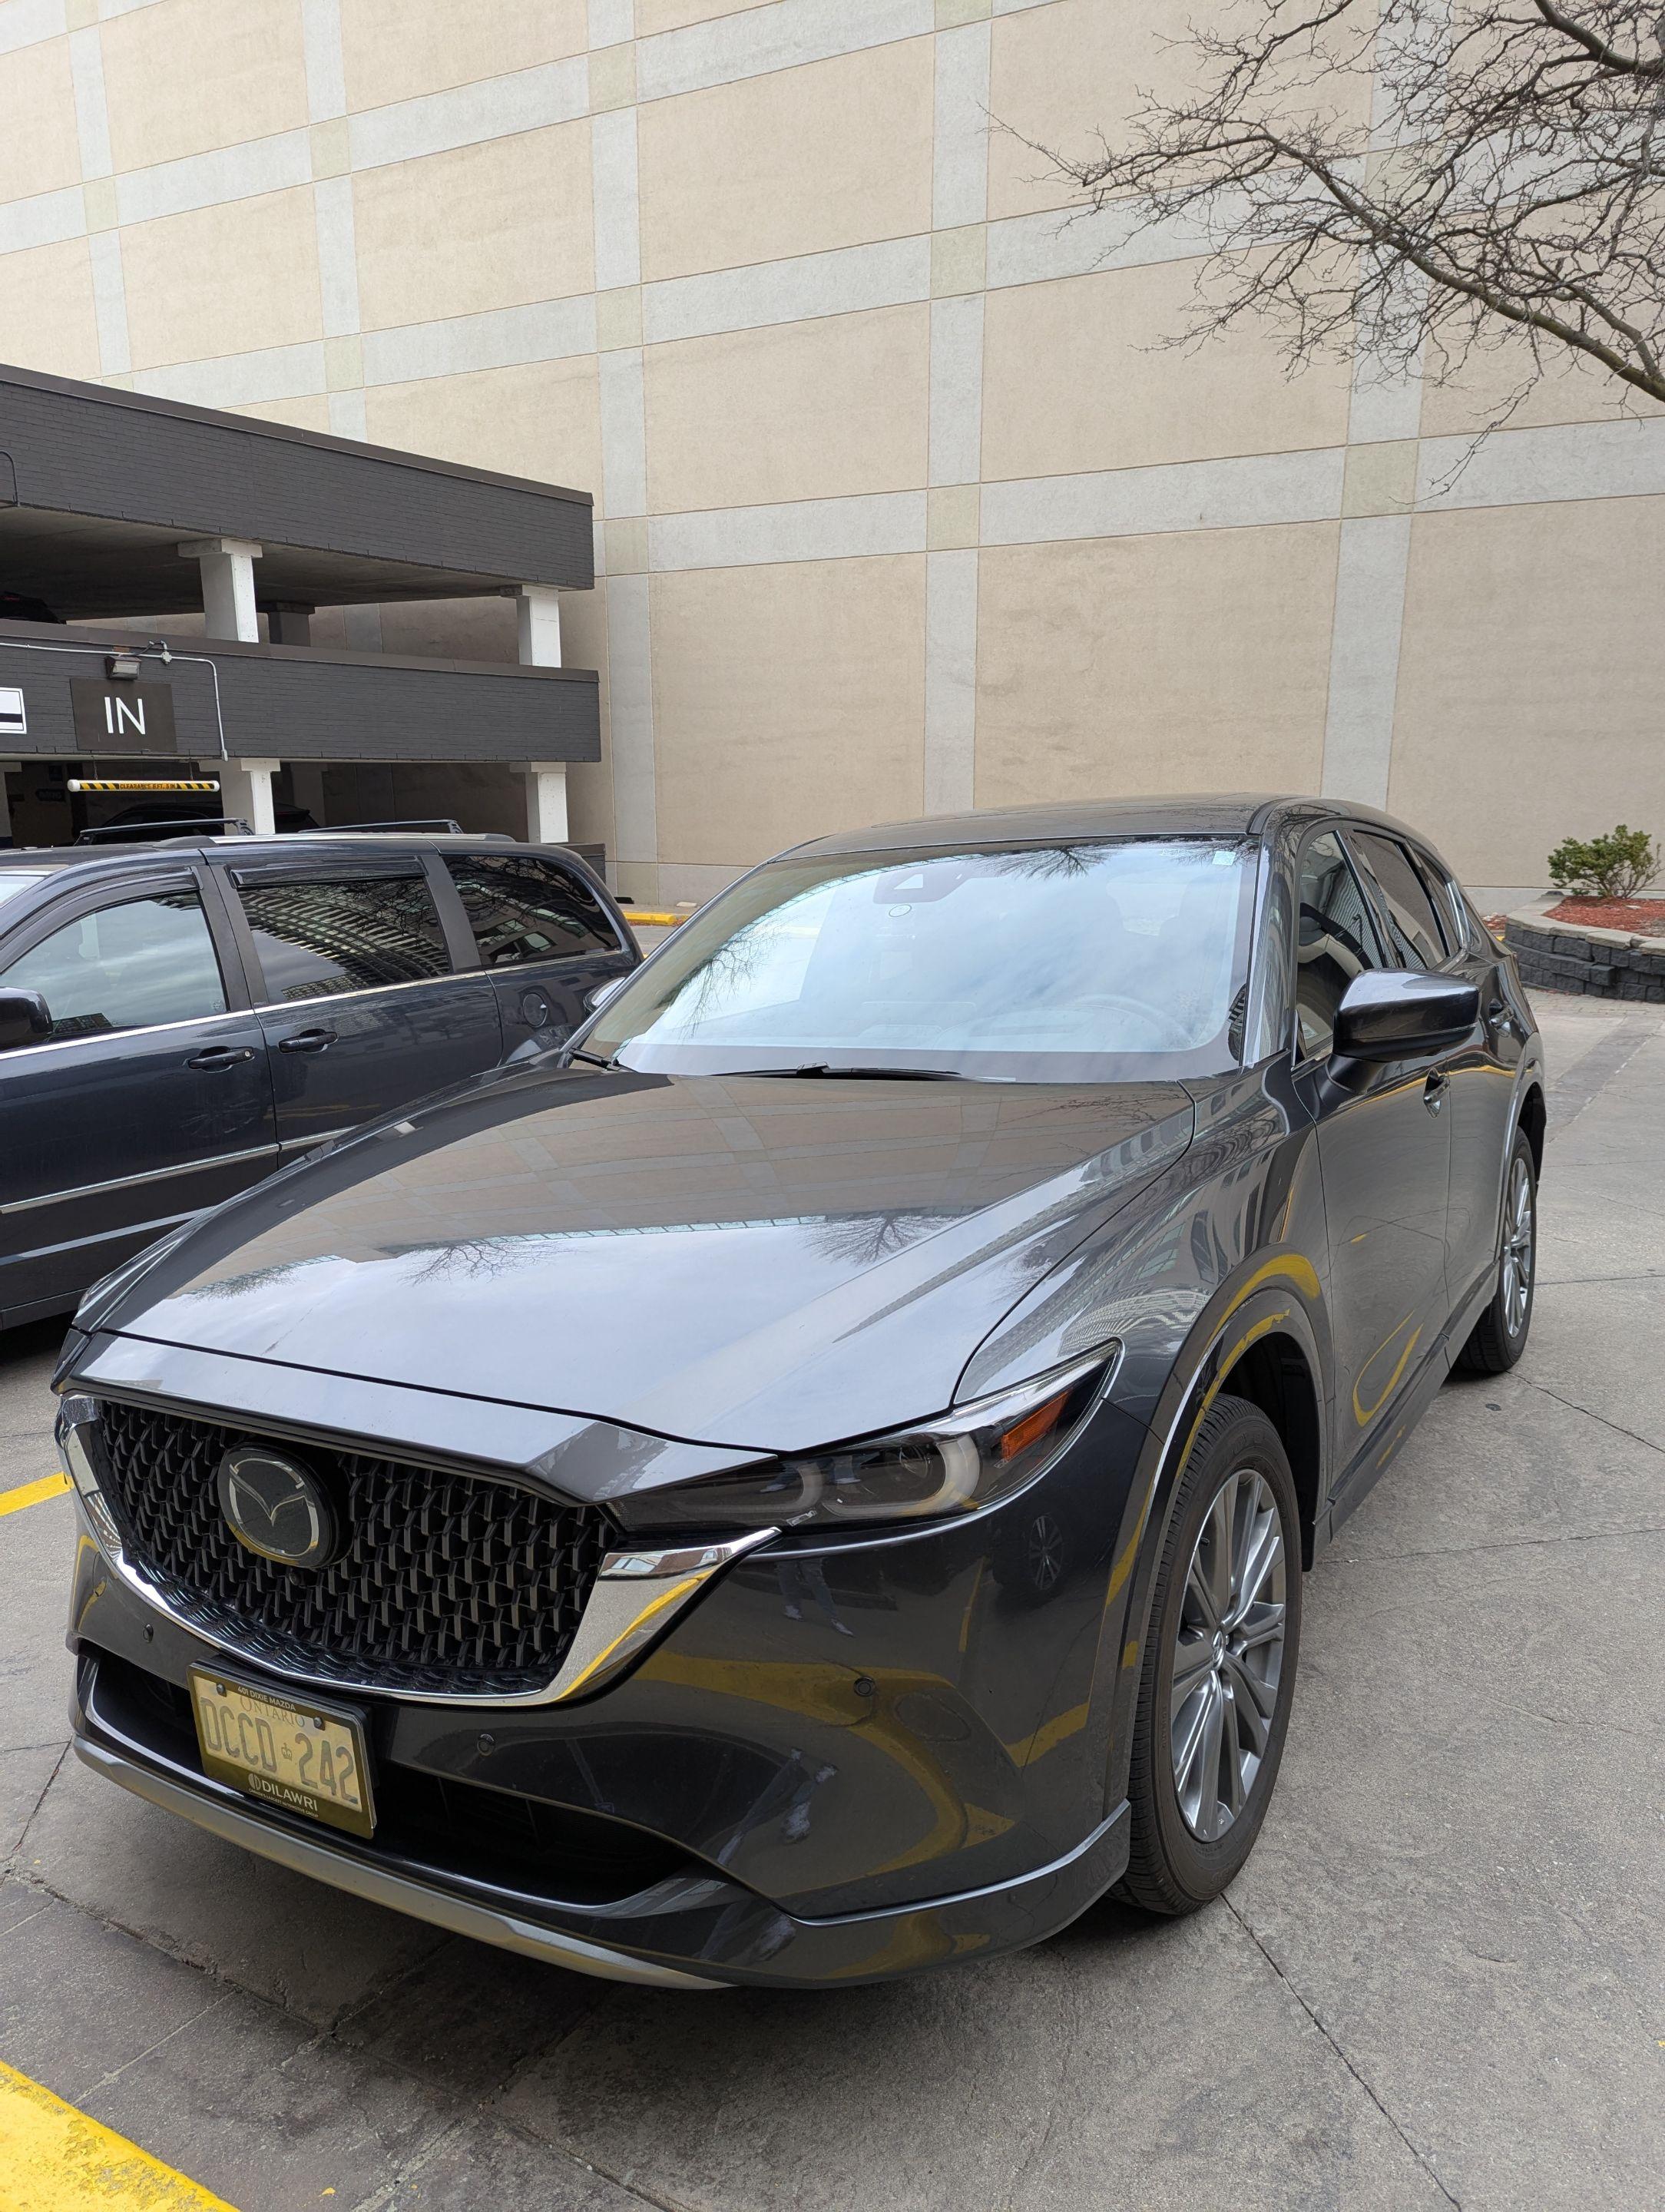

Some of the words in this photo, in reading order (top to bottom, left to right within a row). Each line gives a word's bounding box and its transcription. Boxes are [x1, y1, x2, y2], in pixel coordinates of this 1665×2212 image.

[104, 697, 146, 735] IN
[237, 1686, 249, 1697] 401
[250, 1690, 269, 1704] DIXIE
[269, 1696, 296, 1711] MAZDA
[240, 1694, 306, 1727] ONTARIO
[200, 1697, 278, 1773] DCCD
[295, 1732, 359, 1805] 242
[261, 1780, 318, 1811] DILAWRI
